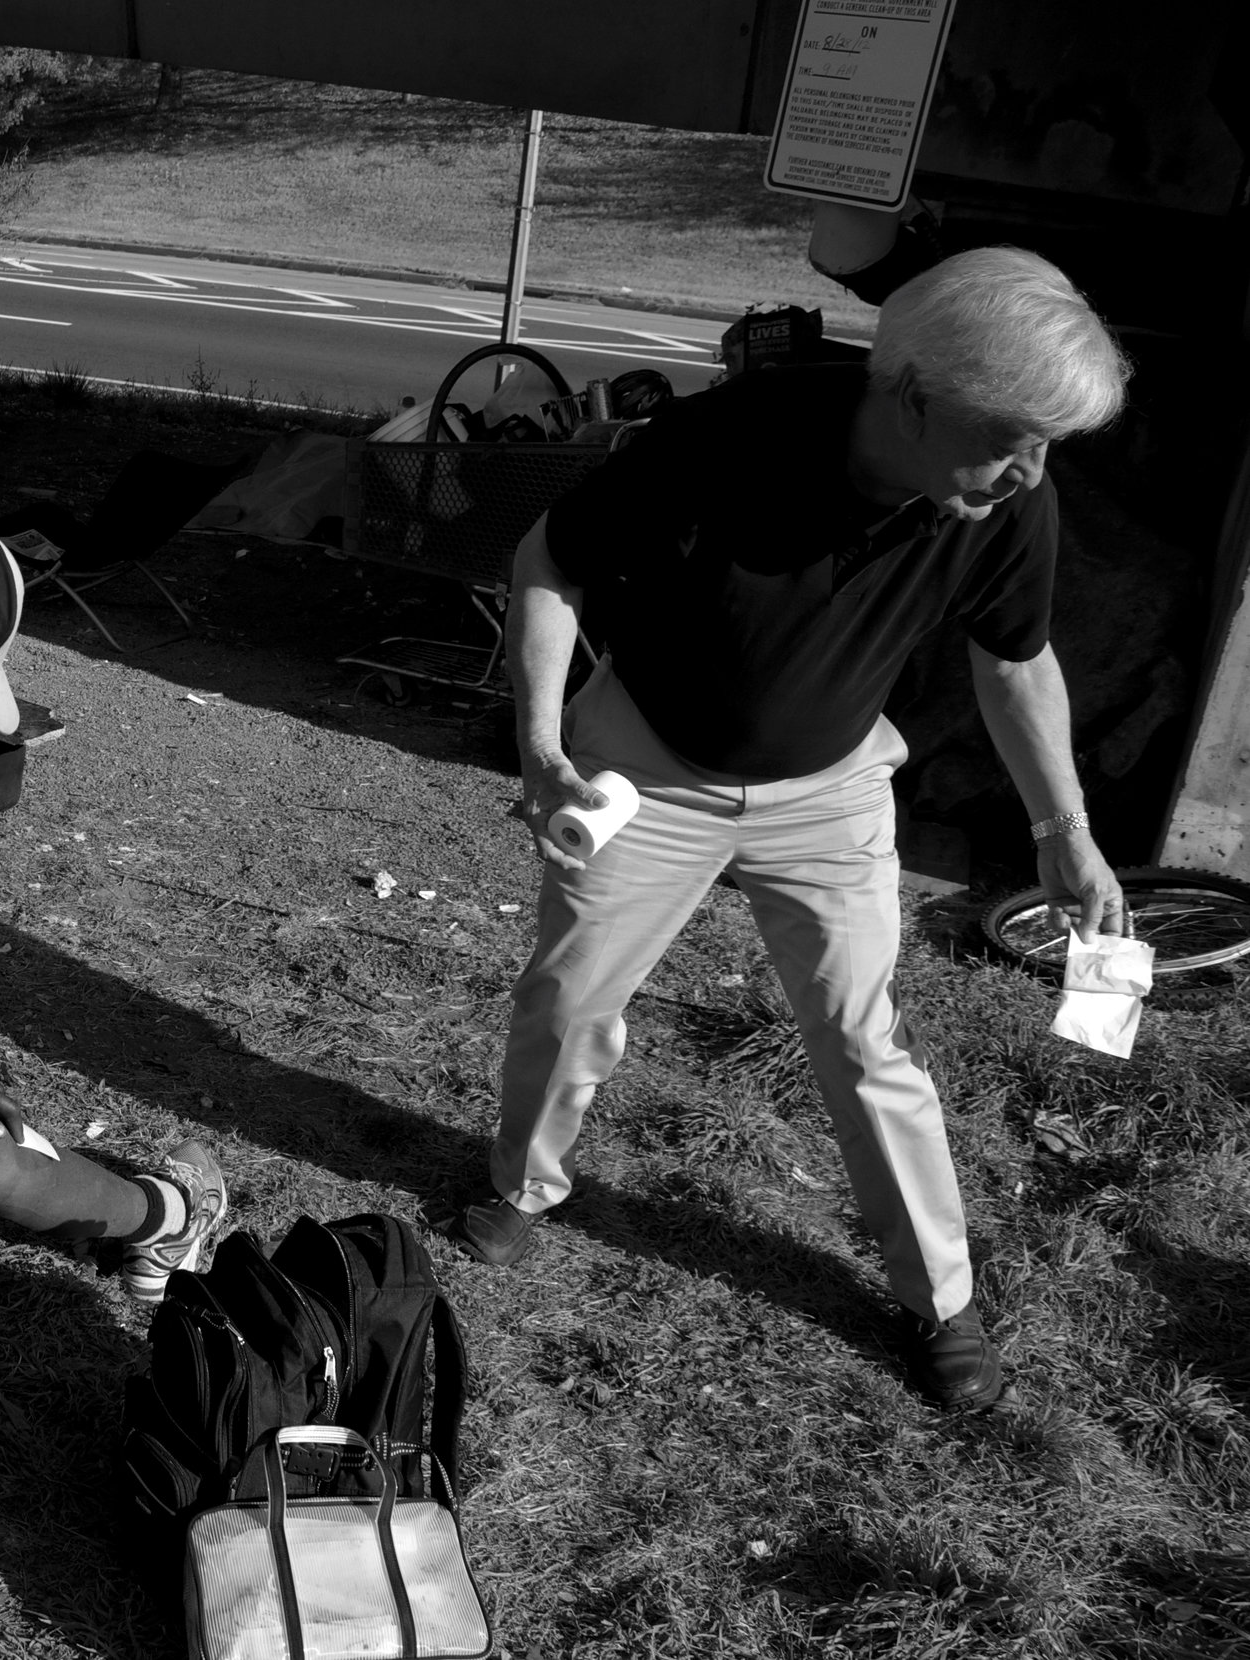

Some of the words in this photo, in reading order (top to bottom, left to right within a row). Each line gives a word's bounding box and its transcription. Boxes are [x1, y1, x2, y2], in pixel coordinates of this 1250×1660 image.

[816, 0, 839, 9] CONDUCT
[845, 2, 868, 11] GENERAL
[868, 4, 895, 13] CLEAN-UP
[895, 6, 902, 14] OF
[904, 7, 916, 15] THIS
[916, 8, 931, 16] AREA
[925, 0, 938, 8] WILL
[861, 26, 877, 38] ON
[803, 40, 821, 50] DATE:
[798, 66, 813, 76] TIME:
[803, 88, 828, 97] PERSONAL
[829, 91, 861, 101] BELONGINGS
[873, 96, 898, 105] REMOVED
[898, 99, 915, 108] PRIOR
[799, 97, 811, 105] THIS
[845, 103, 863, 111] SHALL
[865, 105, 872, 113] BE
[873, 106, 903, 117] DISPOSED
[788, 114, 817, 124] TEMPORARY
[818, 118, 841, 128] STORAGE
[842, 121, 853, 129] AND
[854, 123, 866, 131] CAN
[875, 126, 899, 136] CLAIMED
[819, 109, 855, 120] BELONGINGS
[856, 114, 868, 122] MAY
[879, 117, 903, 126] PLACED
[789, 124, 807, 133] PERSON
[835, 131, 849, 139] DAYS
[749, 324, 790, 341] LIVES
